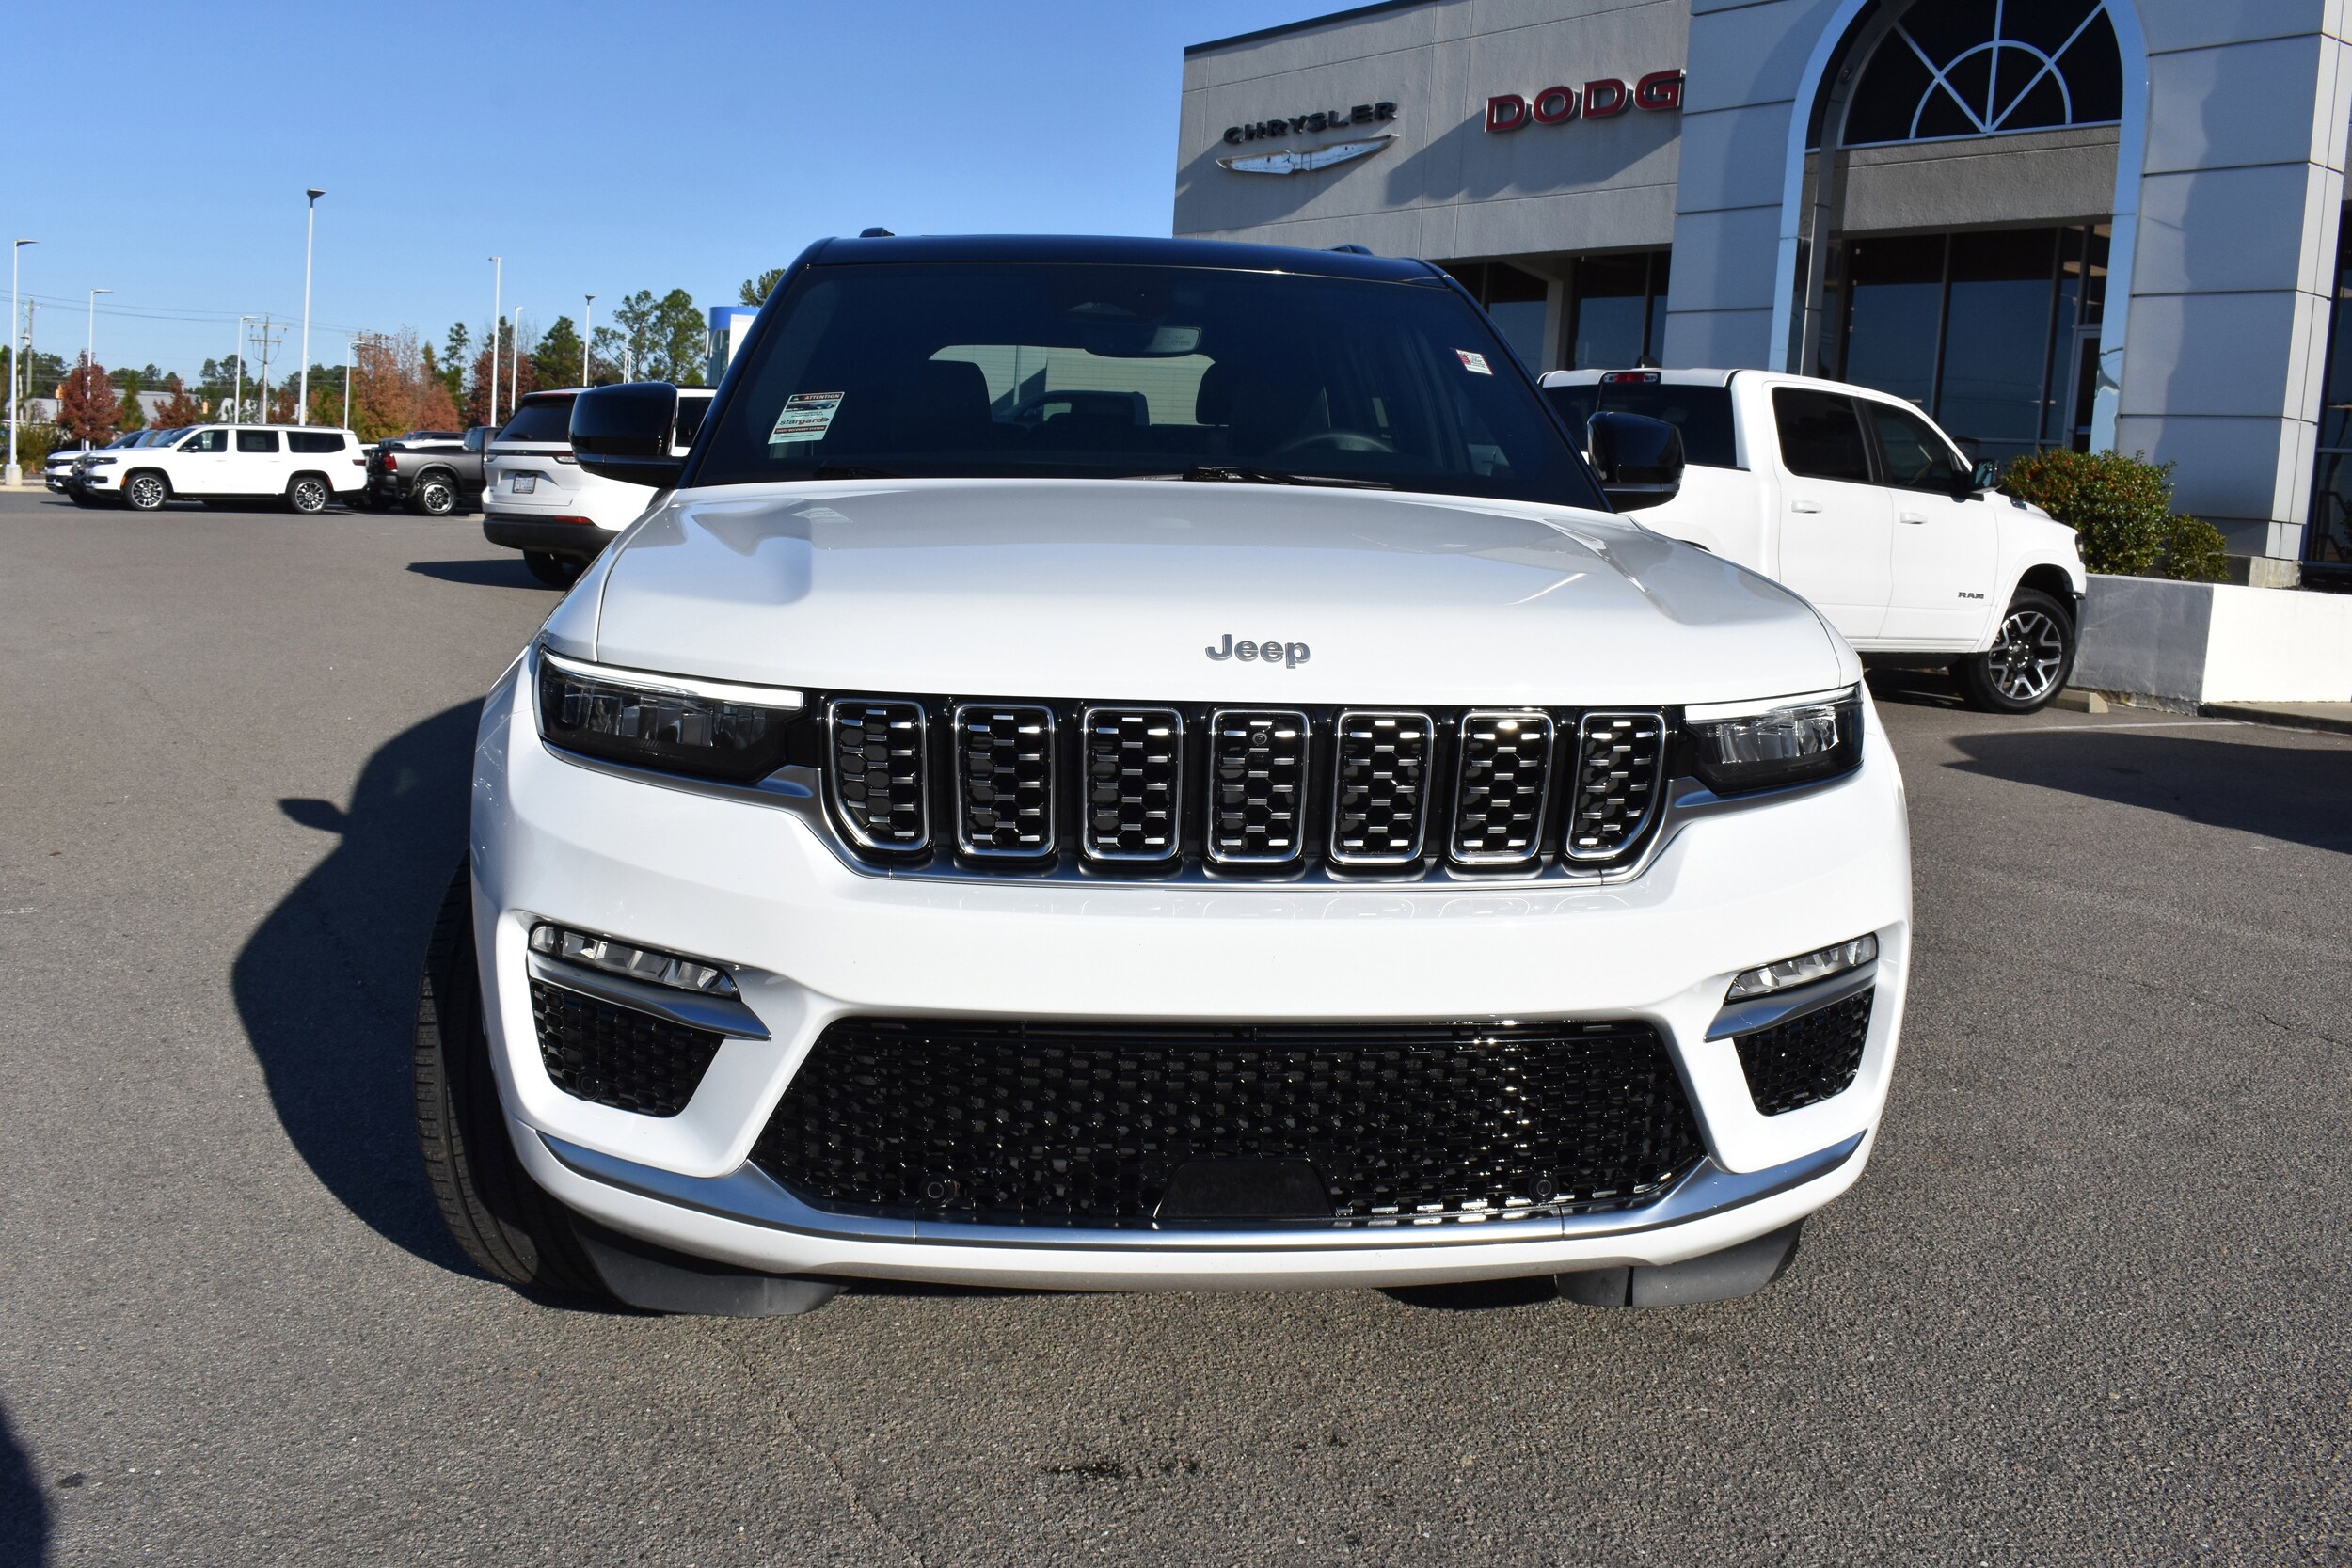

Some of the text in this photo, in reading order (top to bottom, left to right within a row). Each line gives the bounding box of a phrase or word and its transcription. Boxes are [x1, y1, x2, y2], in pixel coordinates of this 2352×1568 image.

[1485, 69, 1685, 133] DODG
[1224, 102, 1398, 144] CHRYSLER
[1205, 634, 1311, 669] Jeep
